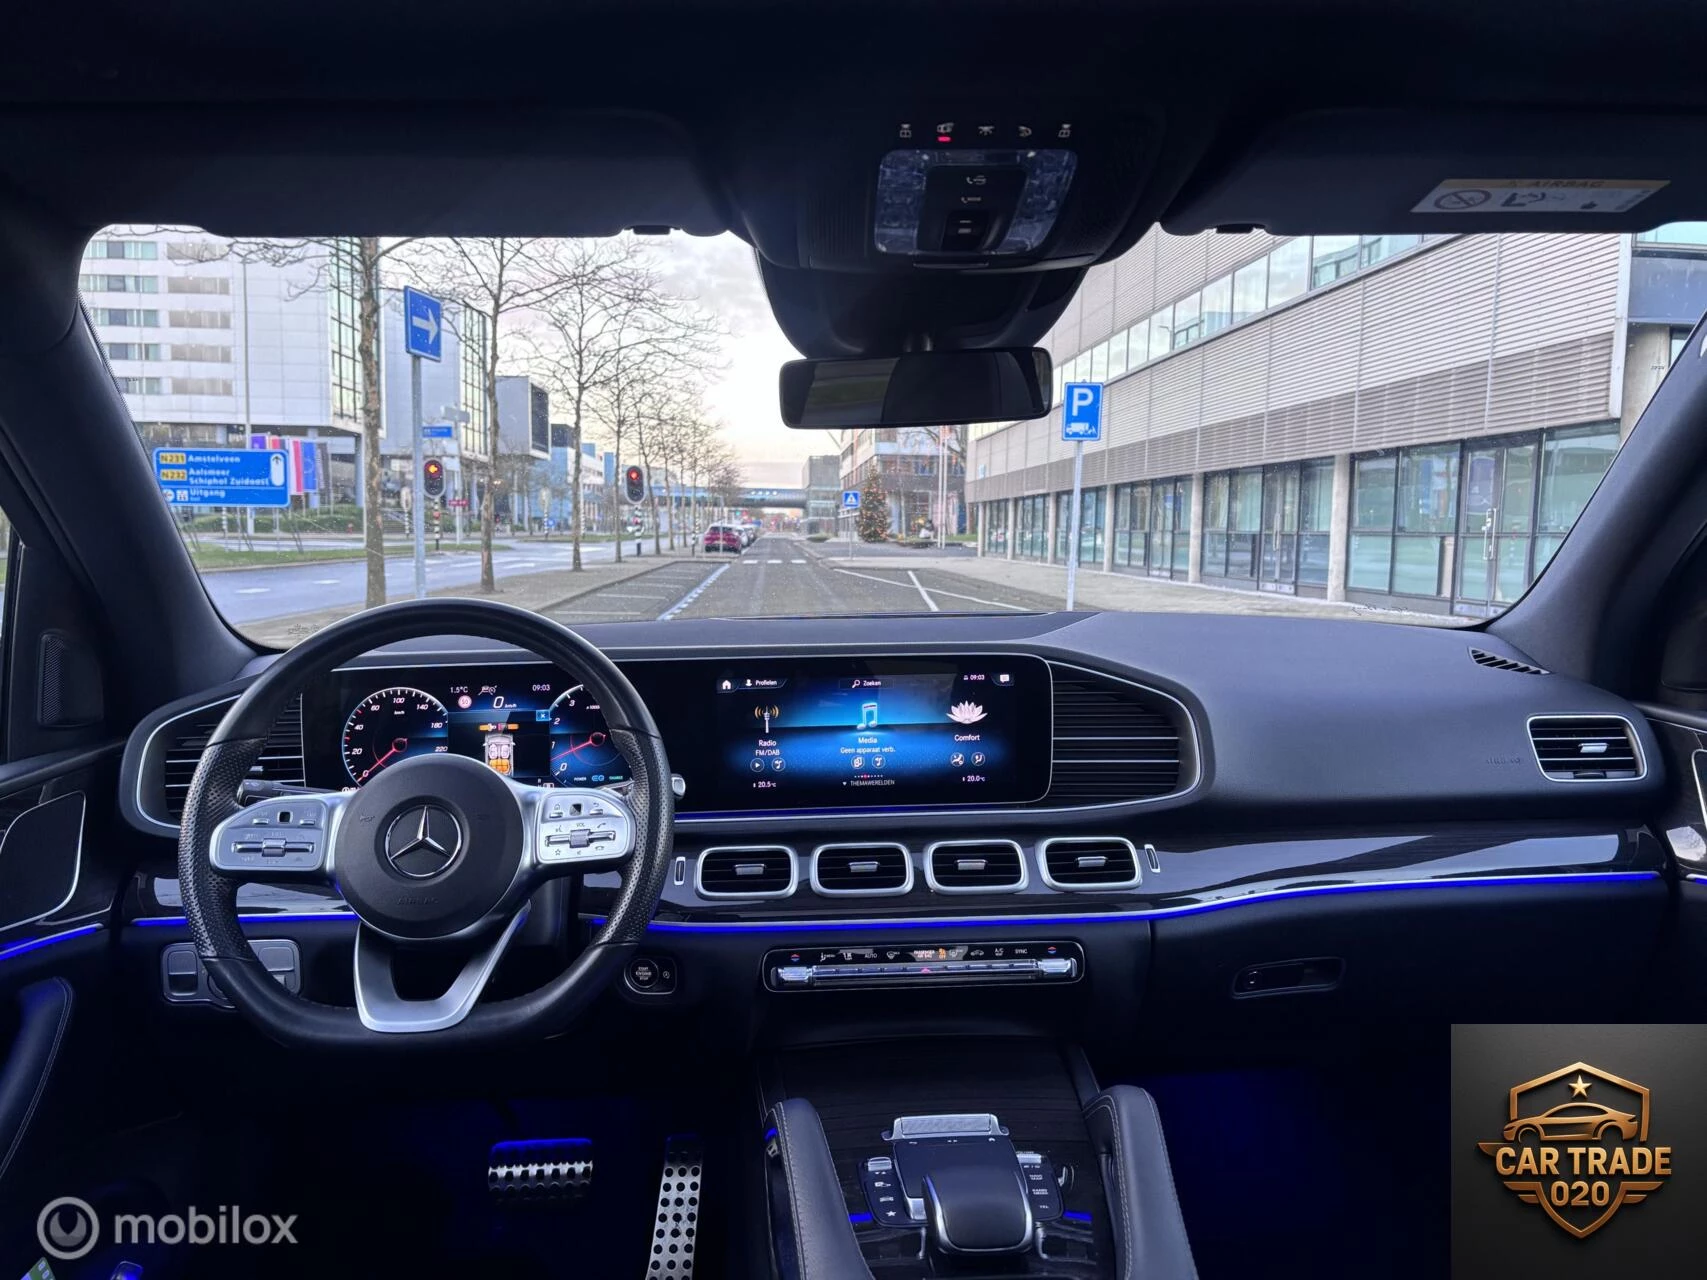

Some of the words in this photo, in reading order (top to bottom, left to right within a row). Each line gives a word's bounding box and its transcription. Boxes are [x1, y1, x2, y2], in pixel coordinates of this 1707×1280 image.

[1072, 387, 1094, 417] P
[188, 454, 240, 463] Amstelveen
[189, 468, 230, 476] Aalsmeer
[189, 477, 228, 486] Schiphol
[230, 477, 270, 486] Zuidoost
[190, 488, 226, 498] Uitgang
[969, 673, 985, 681] 09:03
[755, 679, 778, 687] Profielen
[863, 679, 882, 687] Zoeken
[450, 686, 469, 694] 1.5°C
[532, 684, 551, 692] 09:03
[416, 703, 429, 711] 140
[568, 699, 576, 707] 3
[553, 717, 561, 726] 2
[858, 737, 878, 745] Media
[954, 734, 981, 742] Comfort
[758, 739, 777, 747] Radio
[856, 747, 881, 755] apparaat
[881, 746, 896, 754] verb.
[559, 762, 568, 772] 0
